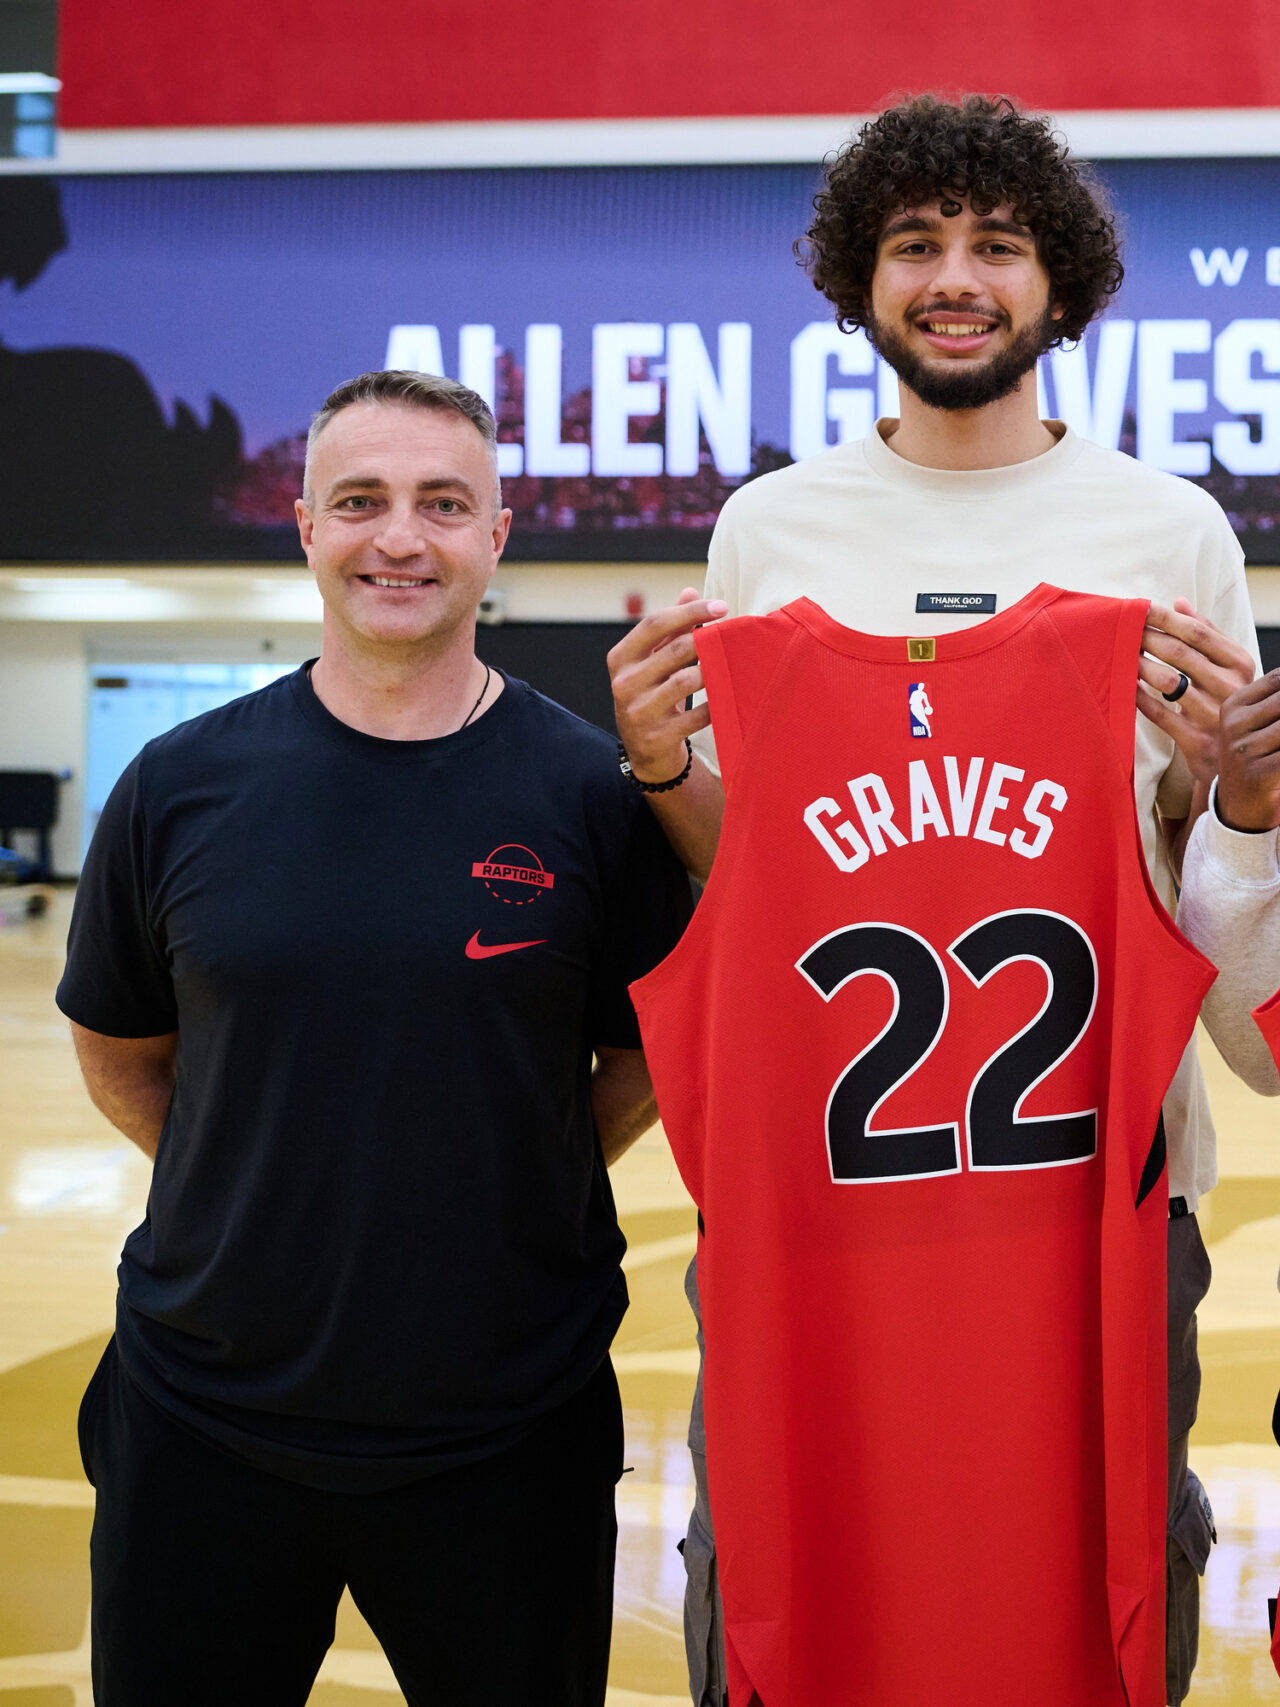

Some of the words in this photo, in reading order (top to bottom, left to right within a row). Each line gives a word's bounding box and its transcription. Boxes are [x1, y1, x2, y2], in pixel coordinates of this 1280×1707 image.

[930, 596, 960, 605] THANK
[962, 597, 983, 605] GOD
[913, 726, 926, 736] NBA
[803, 755, 1069, 873] GRAVES
[482, 865, 545, 884] RAPTORS
[794, 907, 1099, 1185] 22
